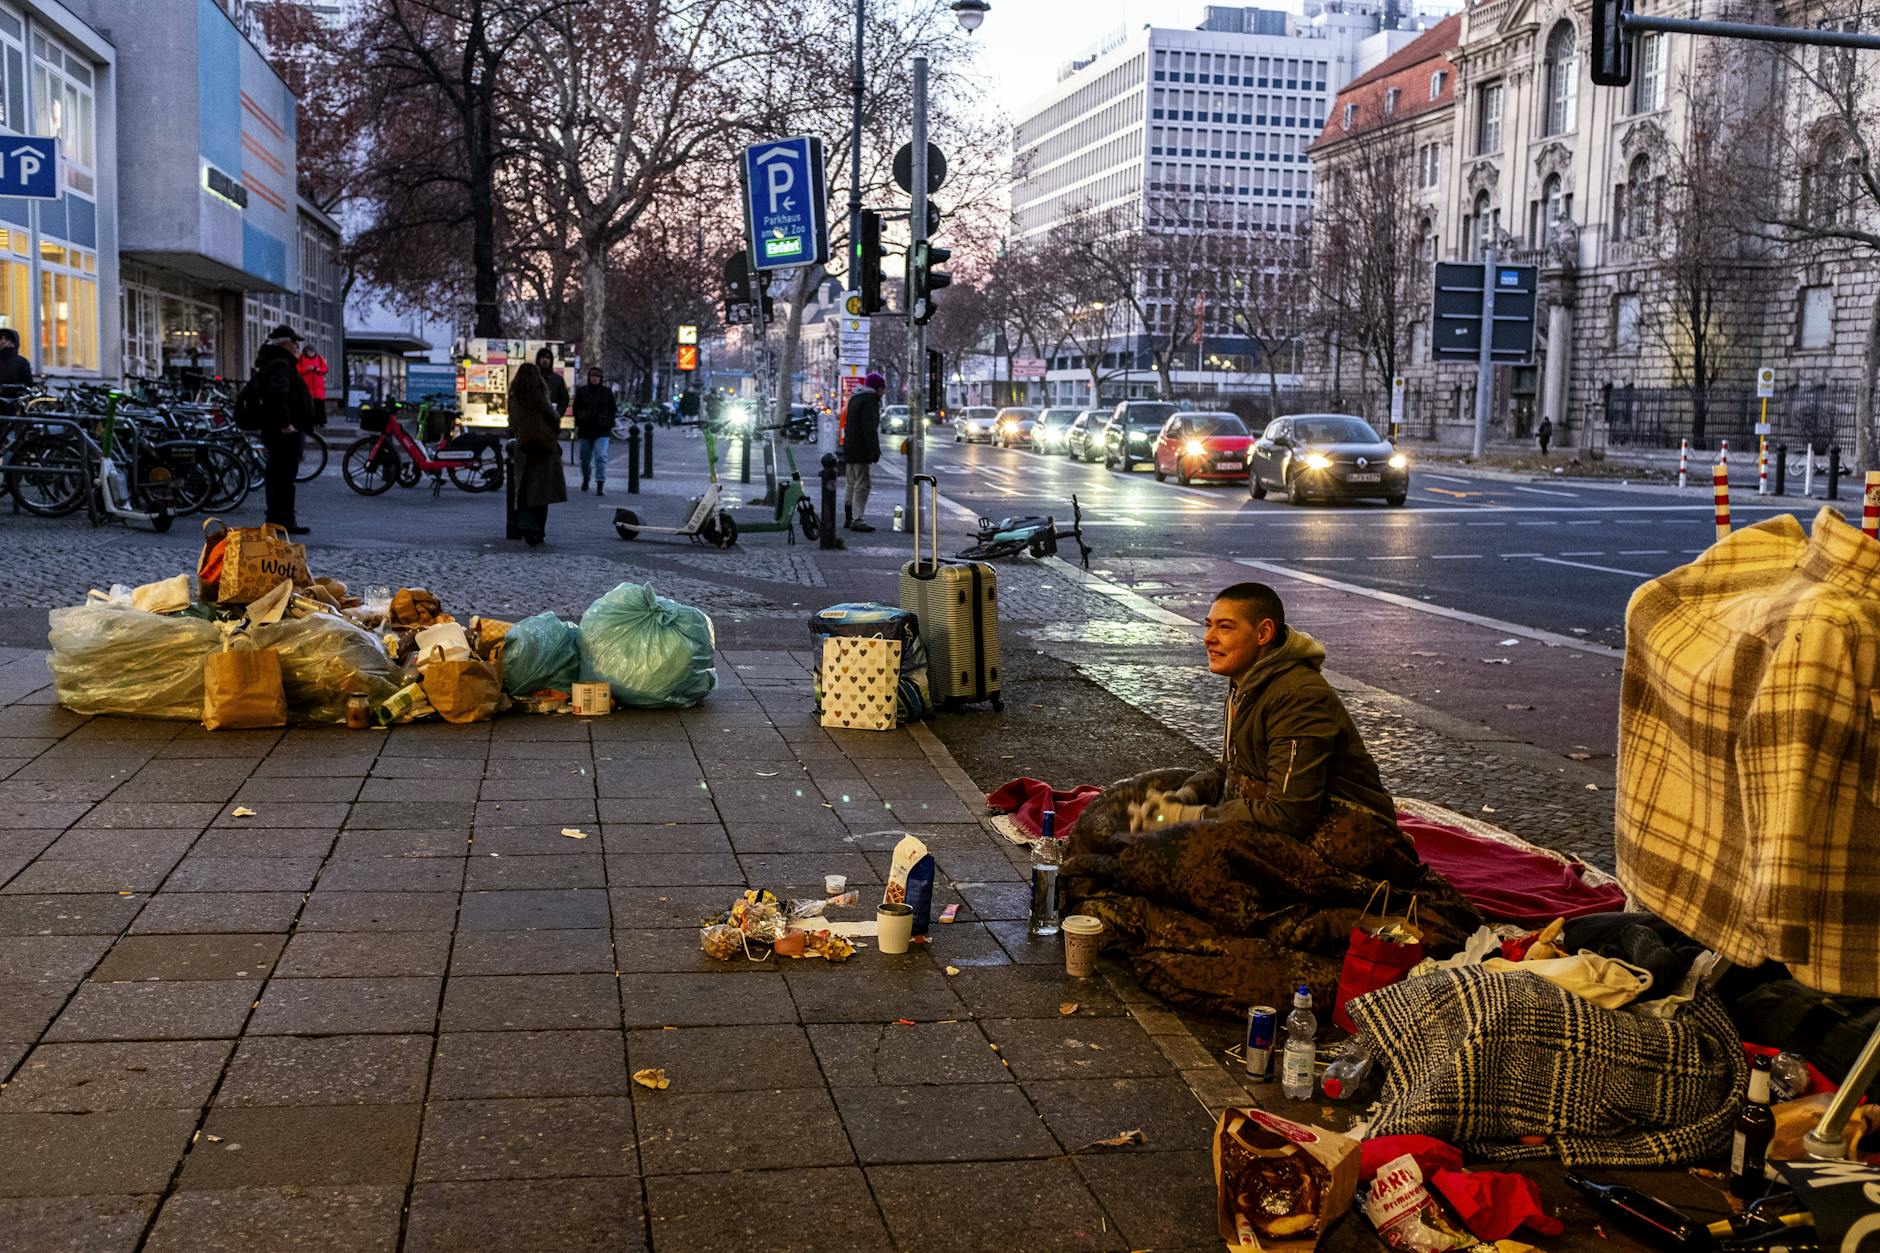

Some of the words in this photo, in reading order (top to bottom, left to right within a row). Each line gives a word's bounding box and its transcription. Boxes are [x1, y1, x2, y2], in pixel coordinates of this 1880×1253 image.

[767, 162, 795, 213] P
[763, 214, 801, 226] Parkhaus
[791, 224, 806, 235] Zoo
[261, 559, 297, 579] Wolt
